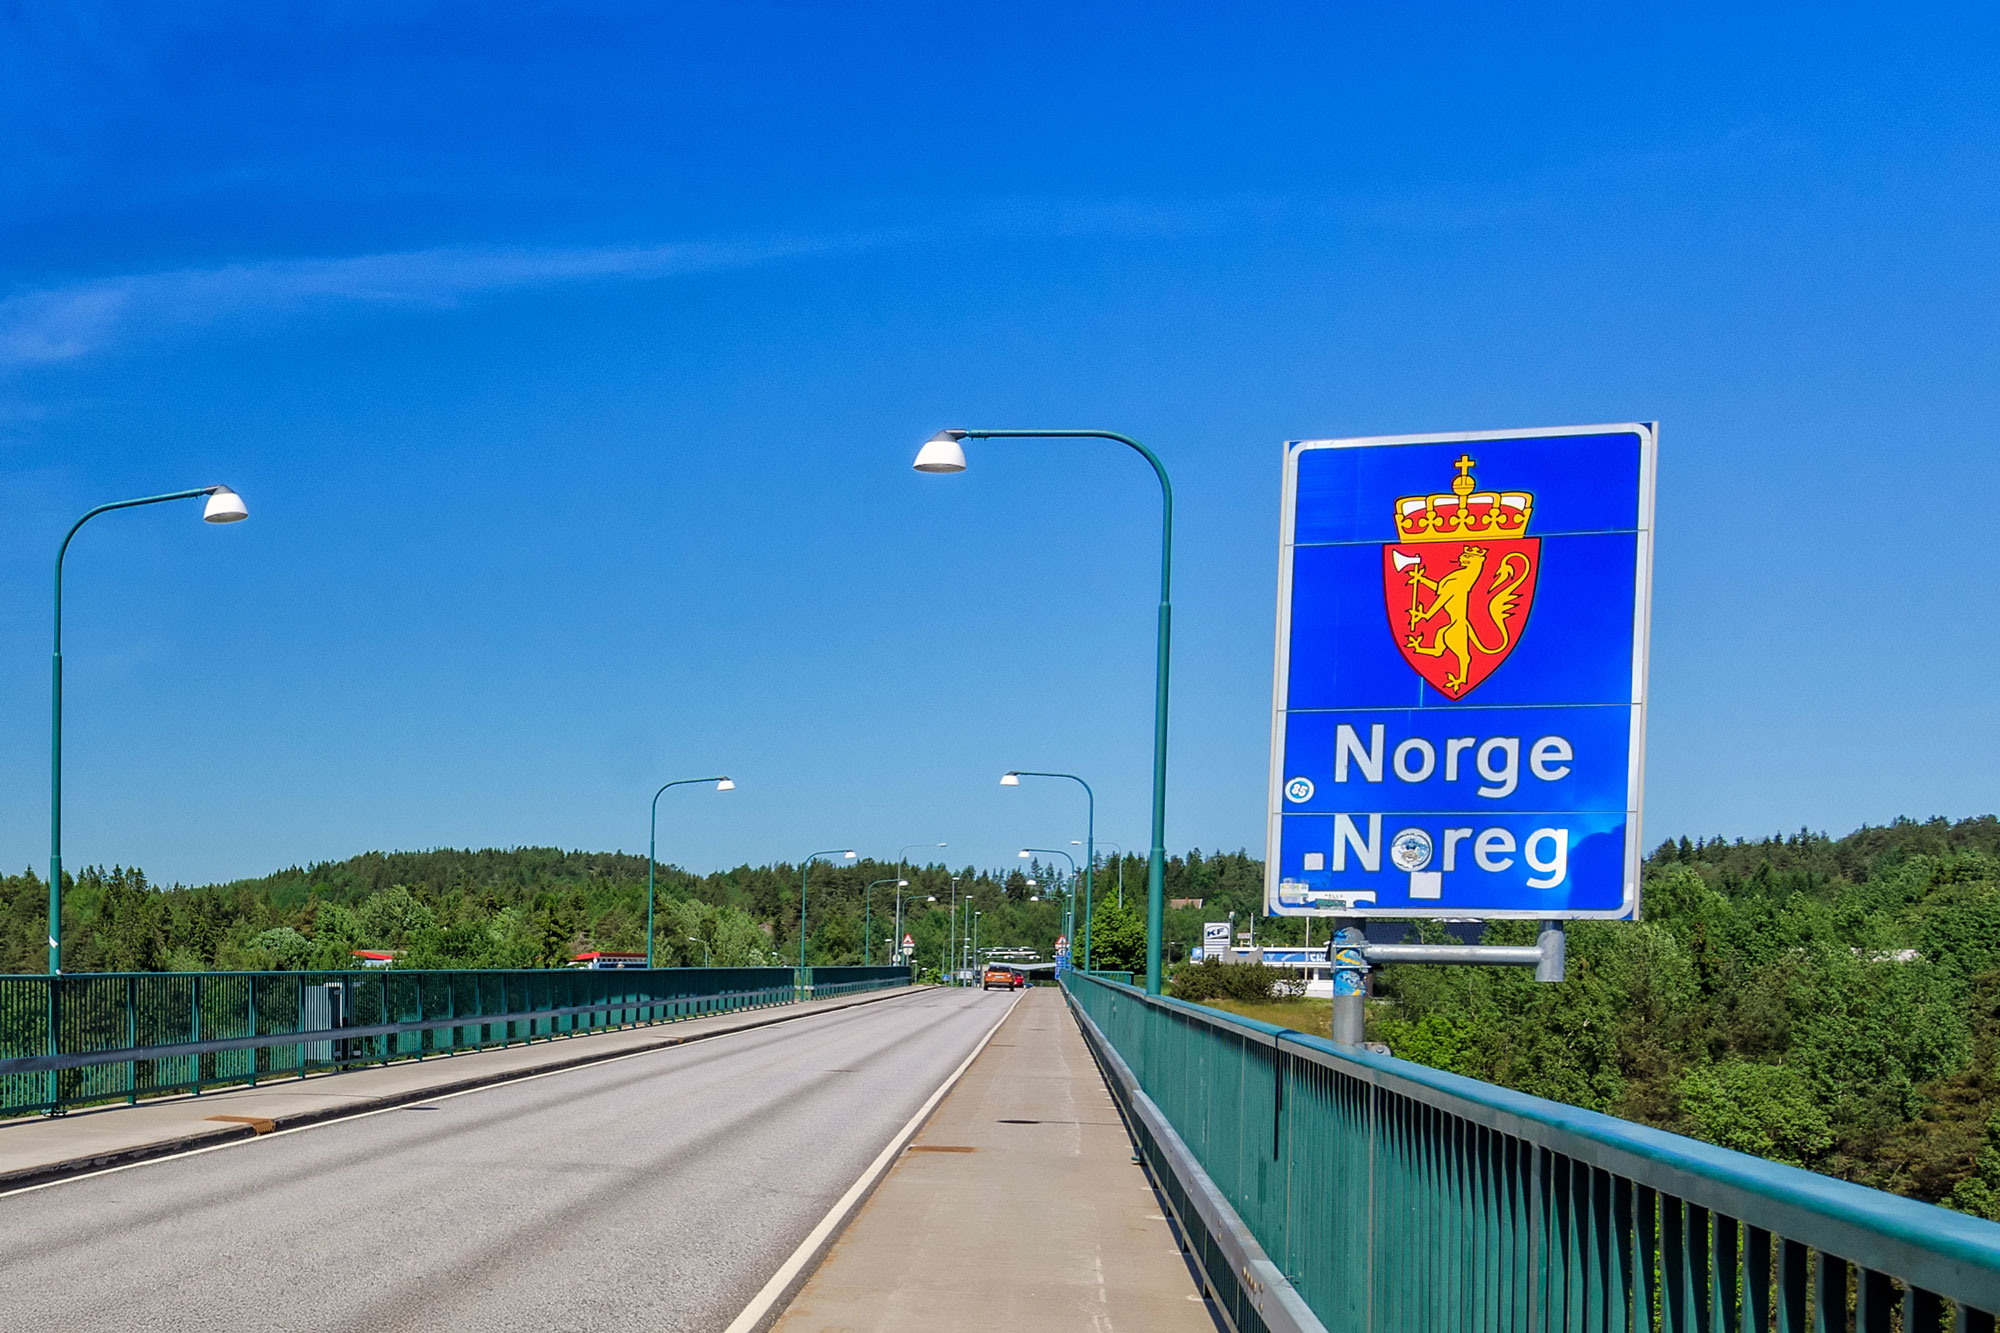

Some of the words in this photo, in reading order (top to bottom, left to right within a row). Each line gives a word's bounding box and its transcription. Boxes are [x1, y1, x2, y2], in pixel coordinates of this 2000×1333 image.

[1335, 723, 1574, 799] Norge
[1291, 783, 1308, 797] 85
[1332, 814, 1569, 889] Noreg
[1206, 927, 1225, 937] KF
